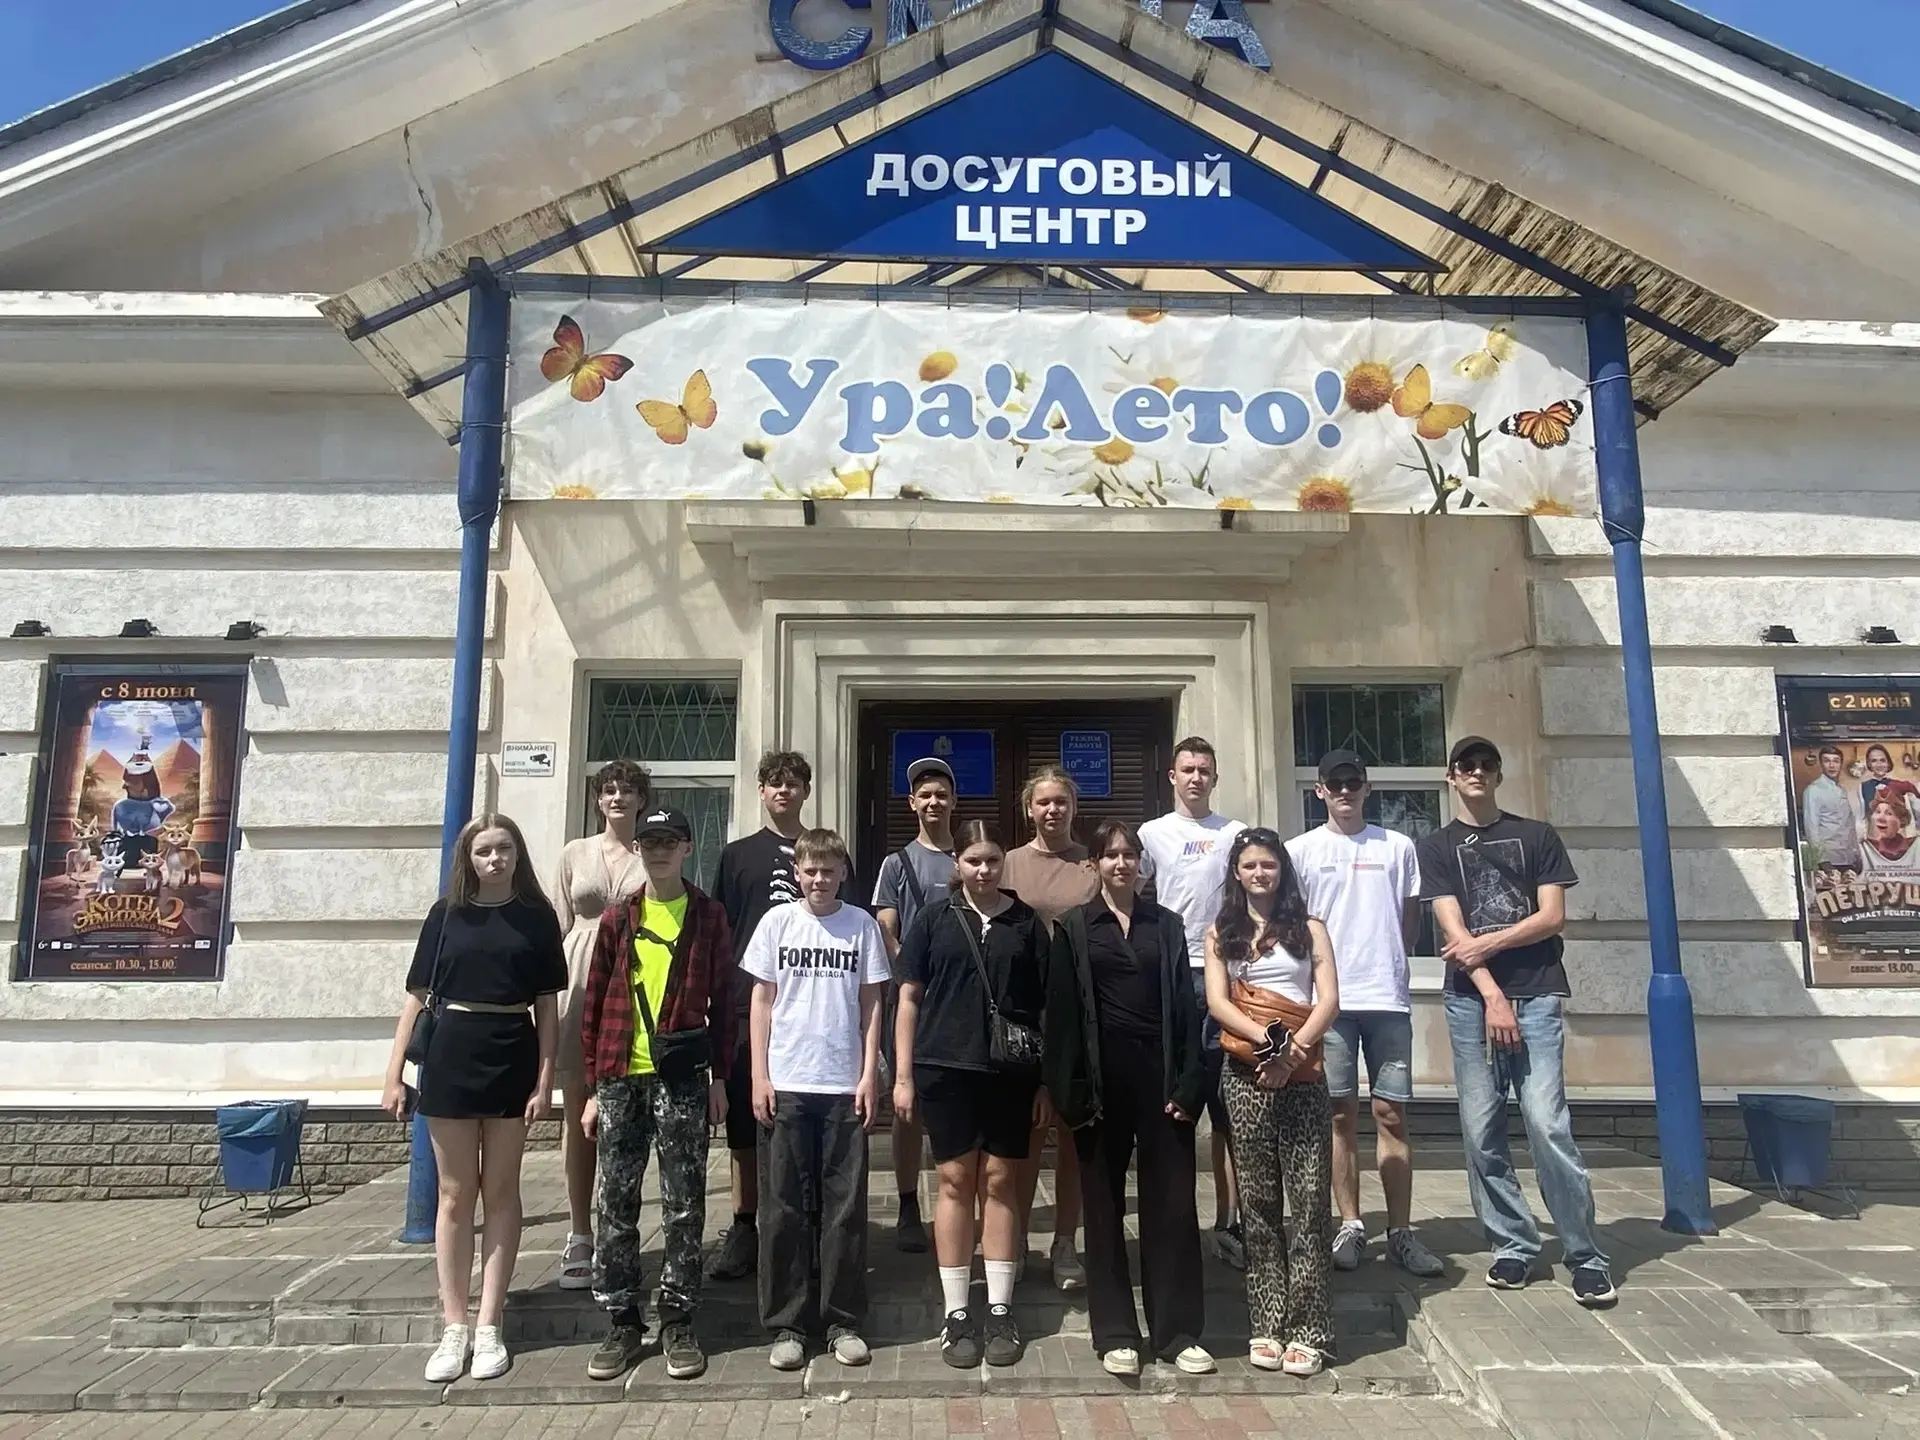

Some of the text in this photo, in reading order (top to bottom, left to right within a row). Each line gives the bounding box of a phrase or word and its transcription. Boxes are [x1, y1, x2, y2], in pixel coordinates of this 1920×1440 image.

[866, 153, 1232, 199] ДОСУГОВЫЙ
[955, 205, 1147, 250] ЦЕНТР
[118, 682, 130, 698] 8
[136, 686, 197, 698] июня
[1844, 694, 1856, 708] 2
[1860, 696, 1912, 708] июня
[1183, 840, 1215, 855] NIKE
[86, 893, 156, 913] КОТЫ
[158, 896, 185, 930] 2
[778, 946, 860, 973] FORTNITE
